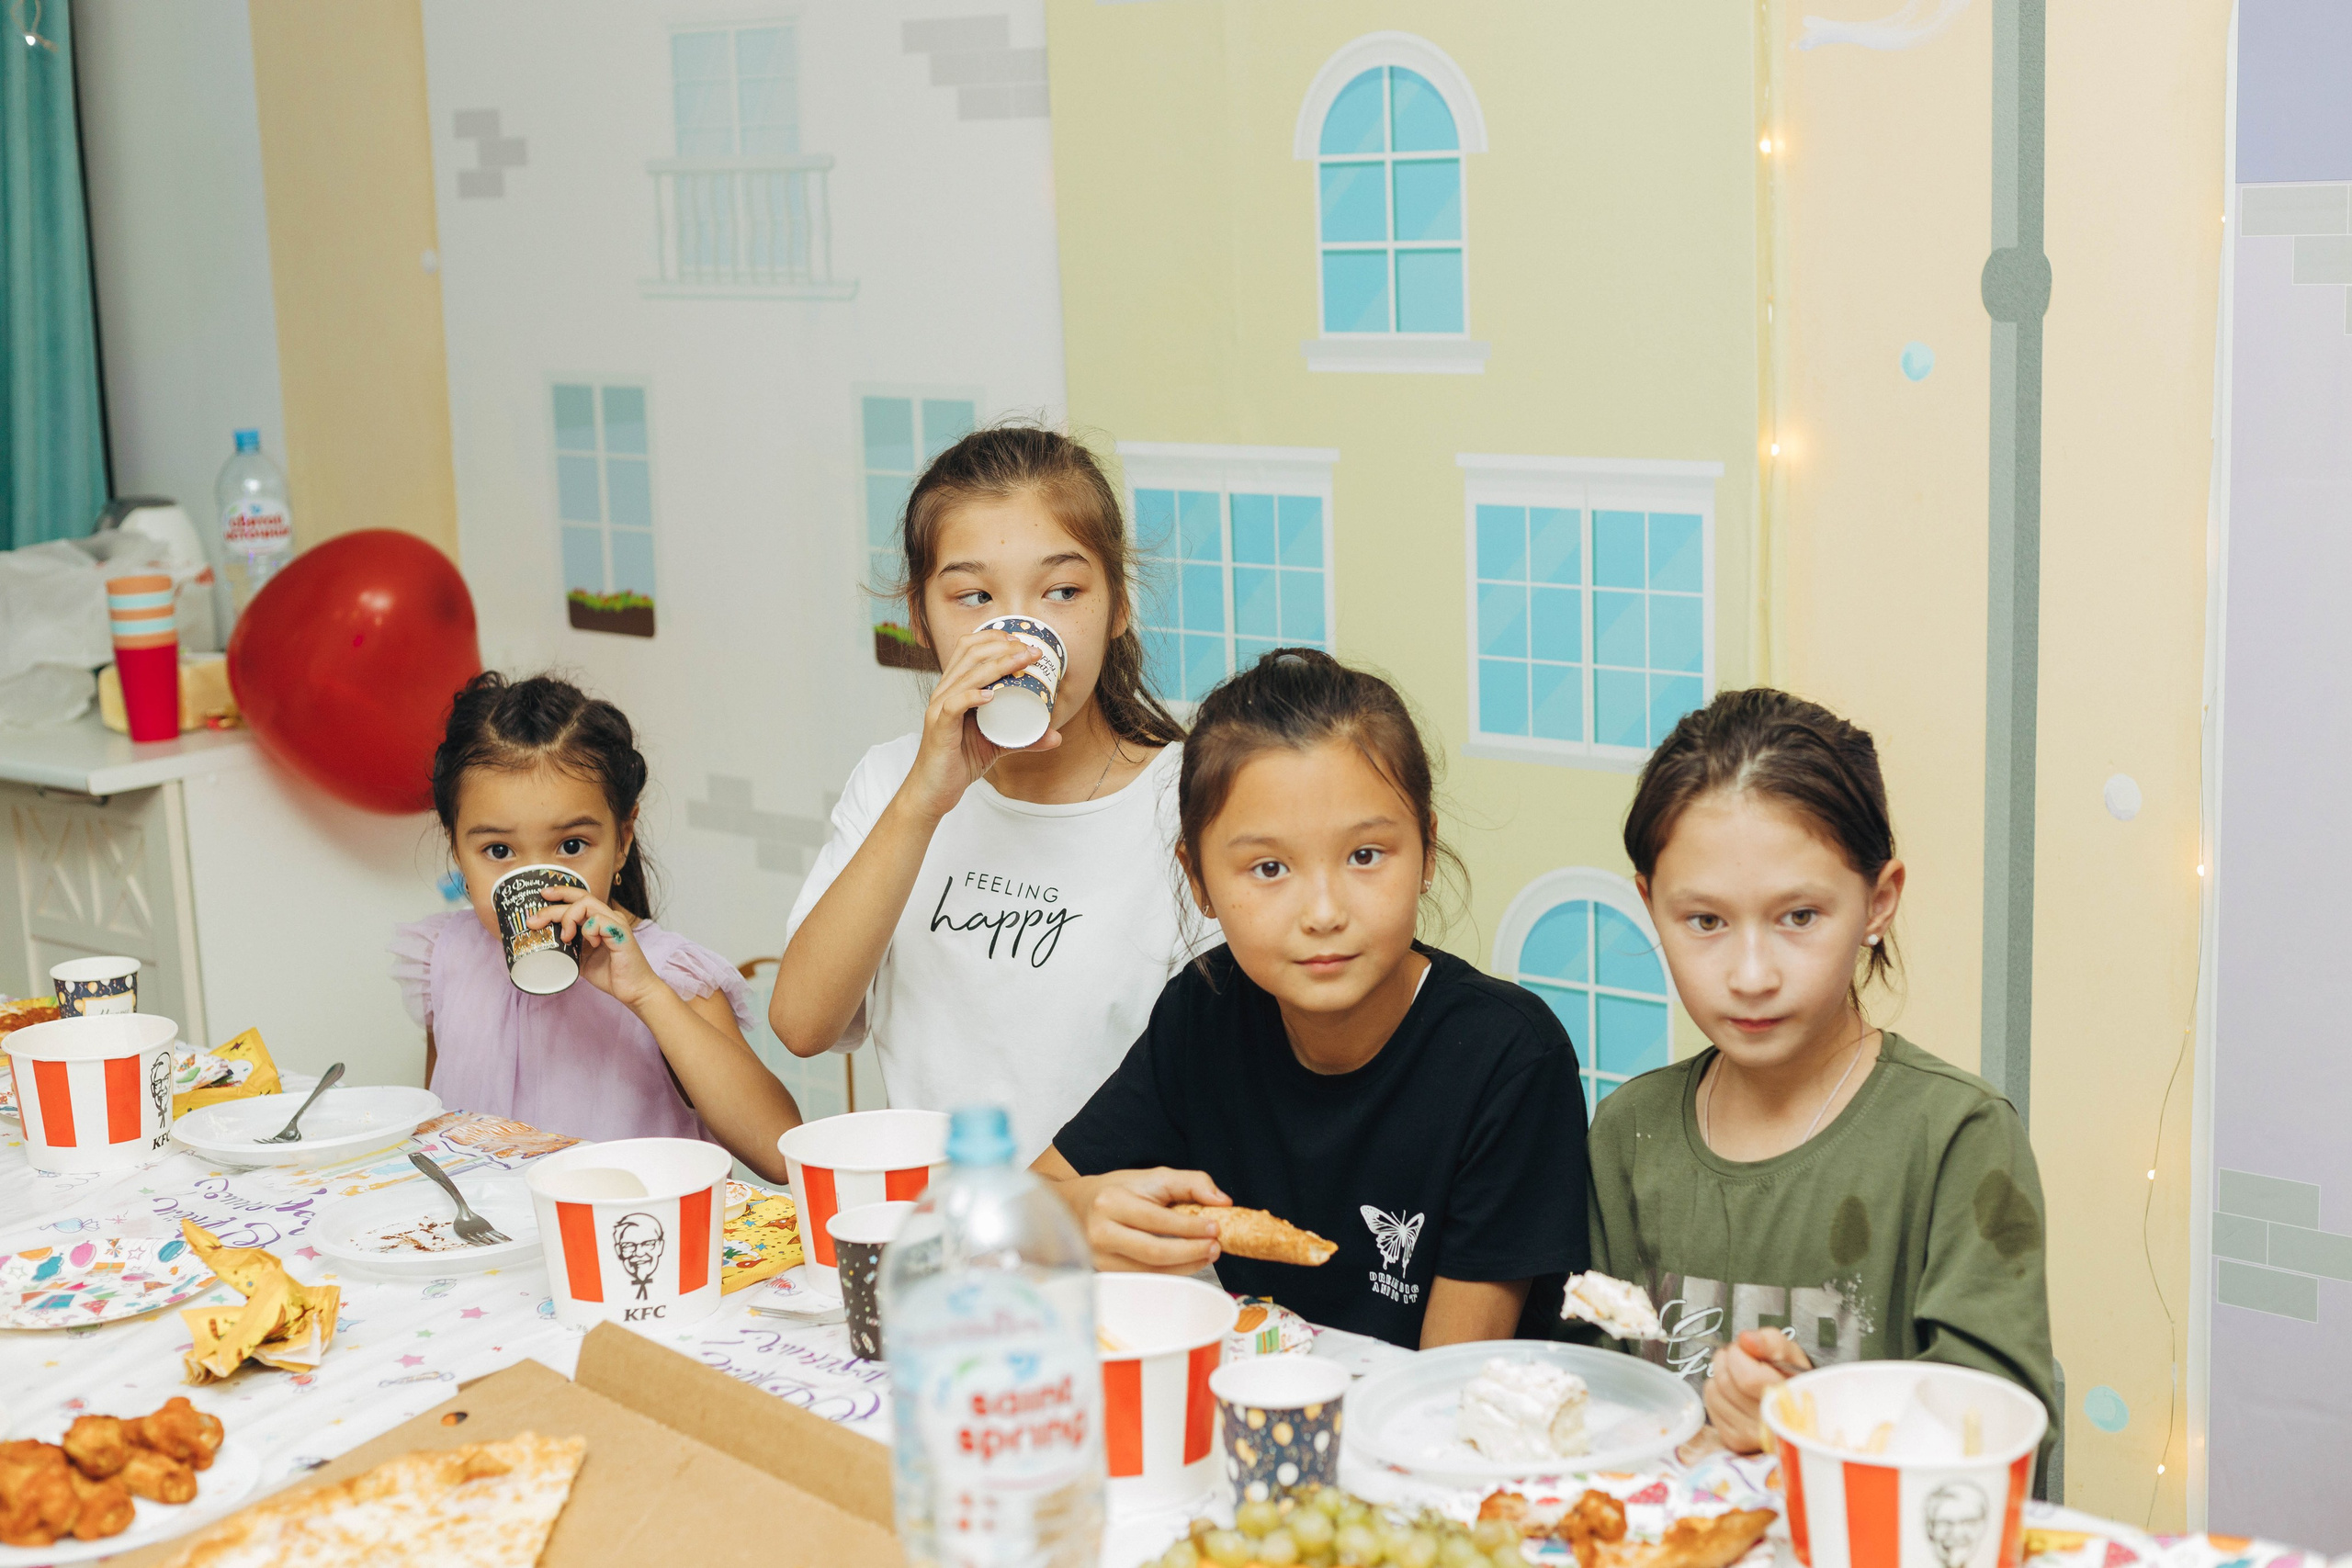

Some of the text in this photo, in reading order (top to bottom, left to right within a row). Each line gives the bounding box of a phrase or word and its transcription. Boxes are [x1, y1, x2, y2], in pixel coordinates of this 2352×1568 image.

[965, 872, 1058, 903] FEELING
[930, 875, 1083, 968] happy
[624, 1304, 666, 1322] KFC
[1403, 1294, 1418, 1303] IT
[970, 1373, 1072, 1416] saint
[957, 1410, 1085, 1463] spring
